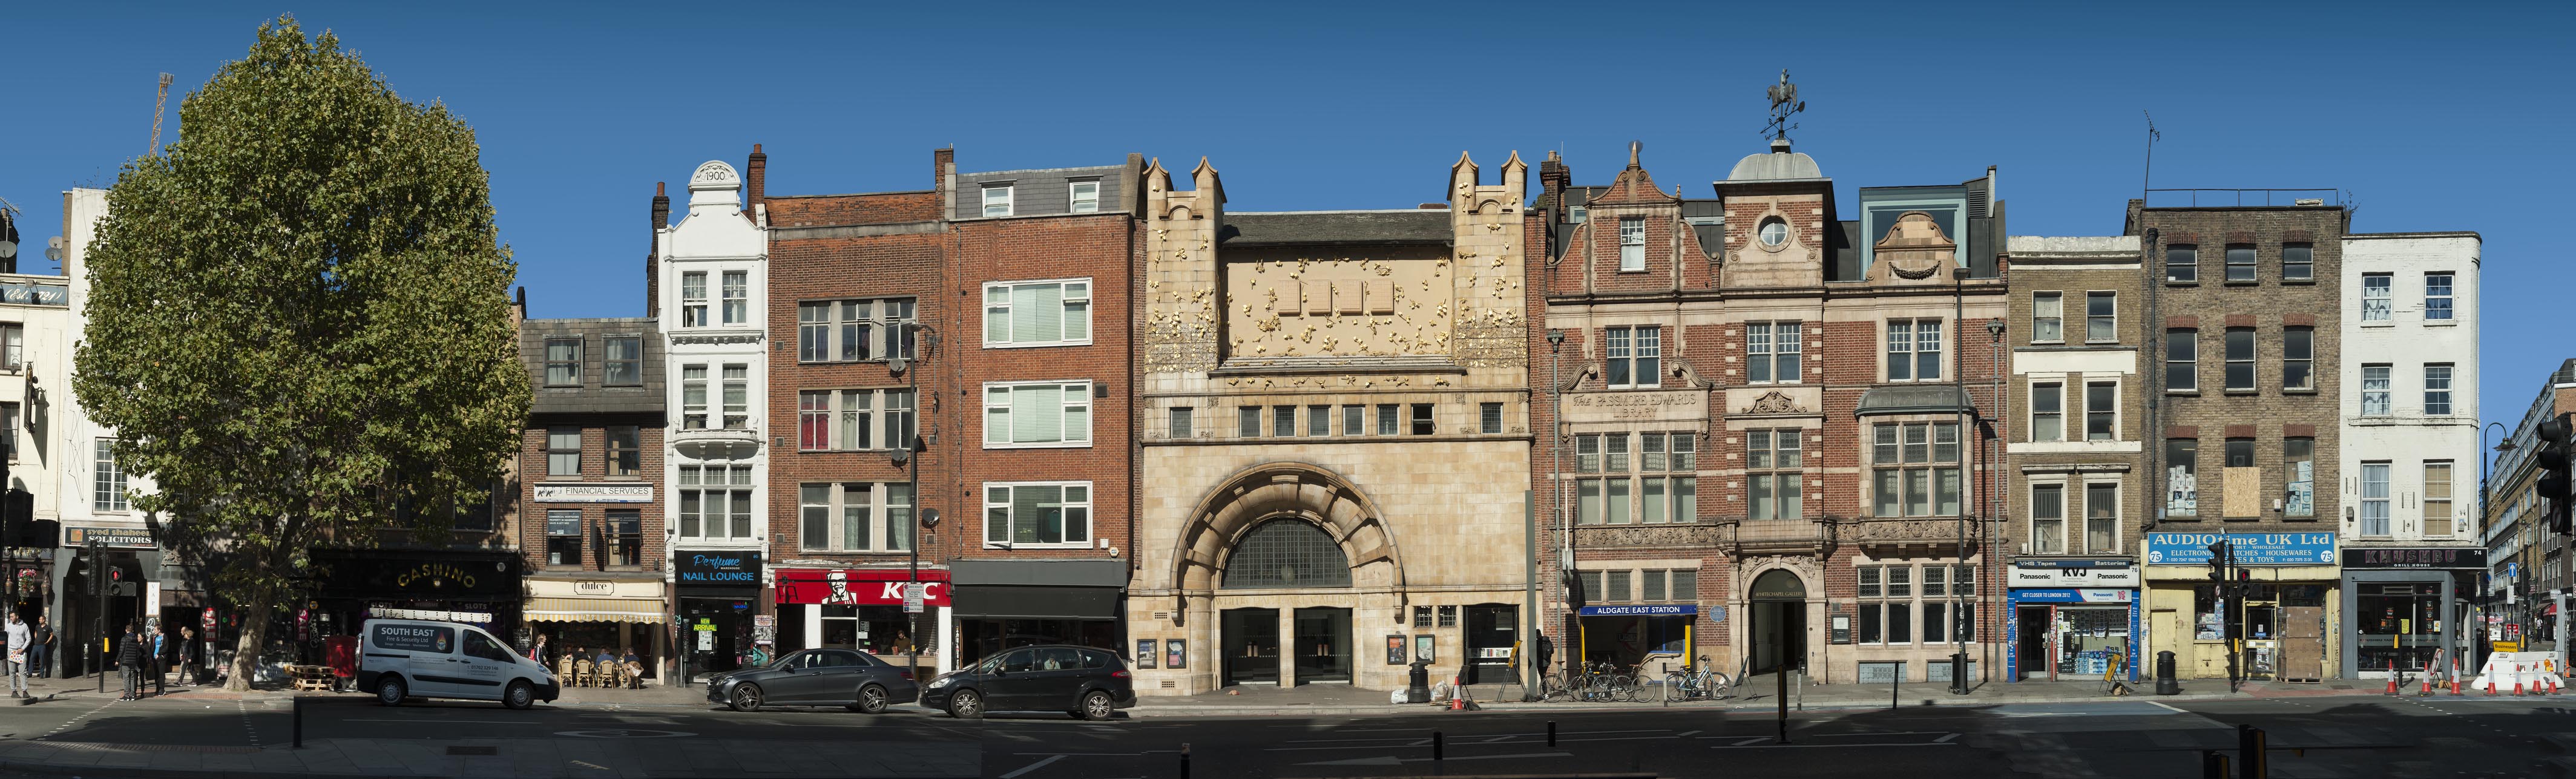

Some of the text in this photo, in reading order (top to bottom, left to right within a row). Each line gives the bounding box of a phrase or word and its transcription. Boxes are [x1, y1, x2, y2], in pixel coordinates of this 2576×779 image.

[706, 171, 725, 180] 1900
[4, 289, 28, 300] (Est.
[1595, 394, 1647, 406] PASSMORE
[1650, 393, 1696, 405] EDWARDS
[1613, 407, 1658, 418] LIBRARY
[2266, 534, 2292, 545] UK
[2301, 534, 2329, 544] Ltd
[693, 554, 740, 569] Perfume
[2365, 550, 2457, 564] KHUSHBU
[398, 563, 475, 588] CASHINO
[683, 572, 754, 581] NAIL LOUNGE
[2063, 567, 2087, 577] KVJ
[582, 582, 607, 590] dulce
[880, 582, 941, 600] KC
[205, 610, 215, 639] SALE
[298, 609, 307, 640] SALE
[381, 627, 410, 636] SOUTH
